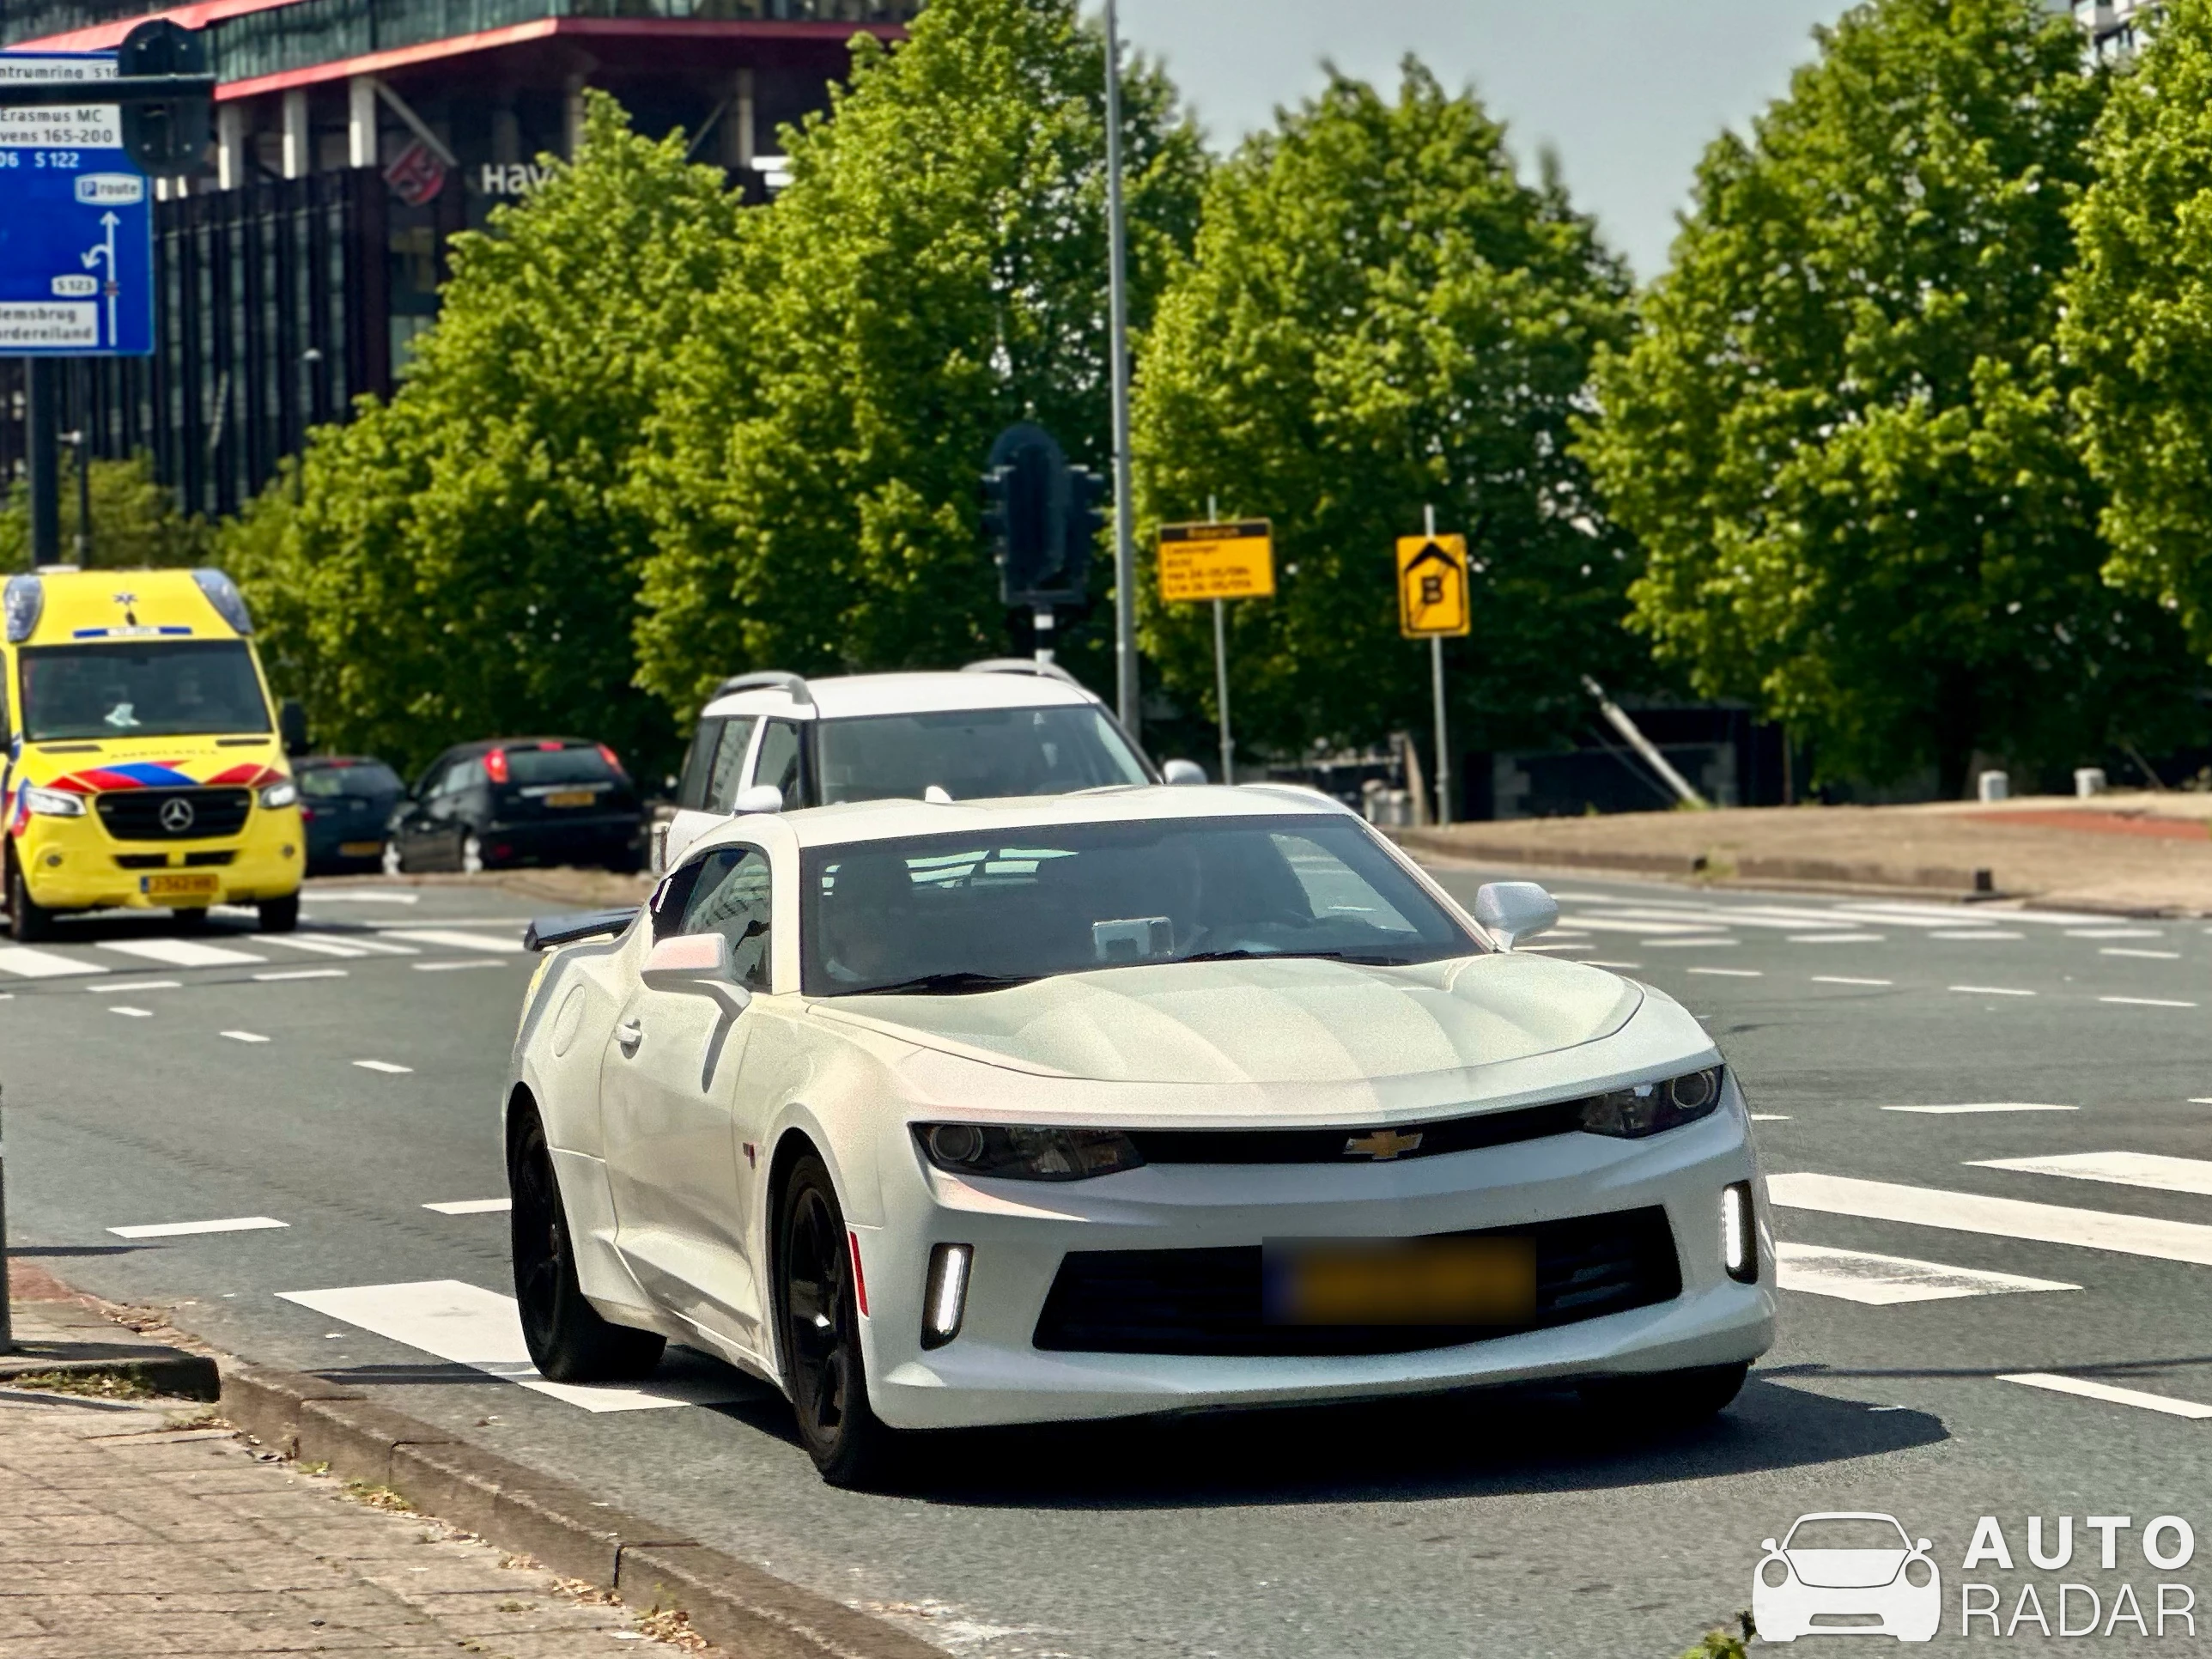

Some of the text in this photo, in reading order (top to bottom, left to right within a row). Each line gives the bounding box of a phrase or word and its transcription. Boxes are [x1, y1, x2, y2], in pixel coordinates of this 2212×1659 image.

[77, 109, 102, 122] MC
[44, 129, 113, 143] 165-200
[100, 182, 137, 196] route
[0, 325, 92, 340] rdereiland
[1421, 576, 1443, 605] B
